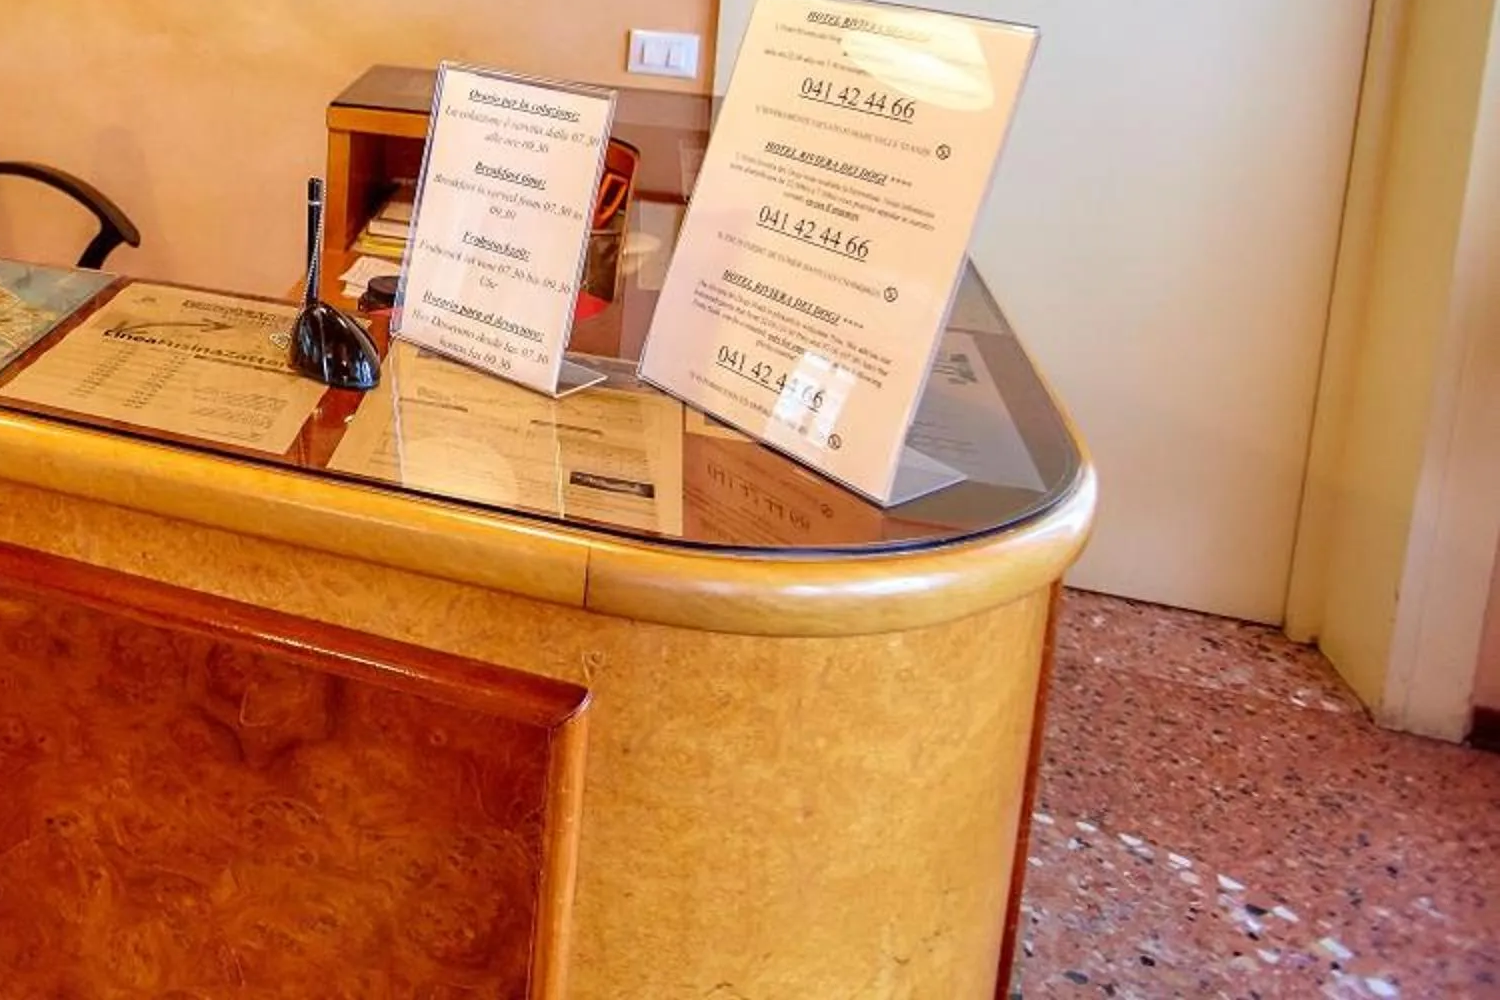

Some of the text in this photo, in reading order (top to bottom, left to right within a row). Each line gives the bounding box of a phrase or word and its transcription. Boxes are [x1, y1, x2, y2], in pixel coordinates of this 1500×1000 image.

[801, 76, 916, 120] 041 42 44 66
[475, 161, 519, 183] Breakfast
[764, 141, 797, 160] HOTEL
[799, 150, 839, 172] RIVIERA
[861, 167, 888, 185] DOGI
[758, 205, 790, 231] 041
[793, 218, 816, 239] 42
[819, 225, 841, 249] 44
[845, 234, 871, 259] 66
[722, 269, 753, 292] HOTEL
[753, 281, 795, 308] RIVIERA
[717, 345, 746, 372] 041
[751, 360, 773, 384] 42
